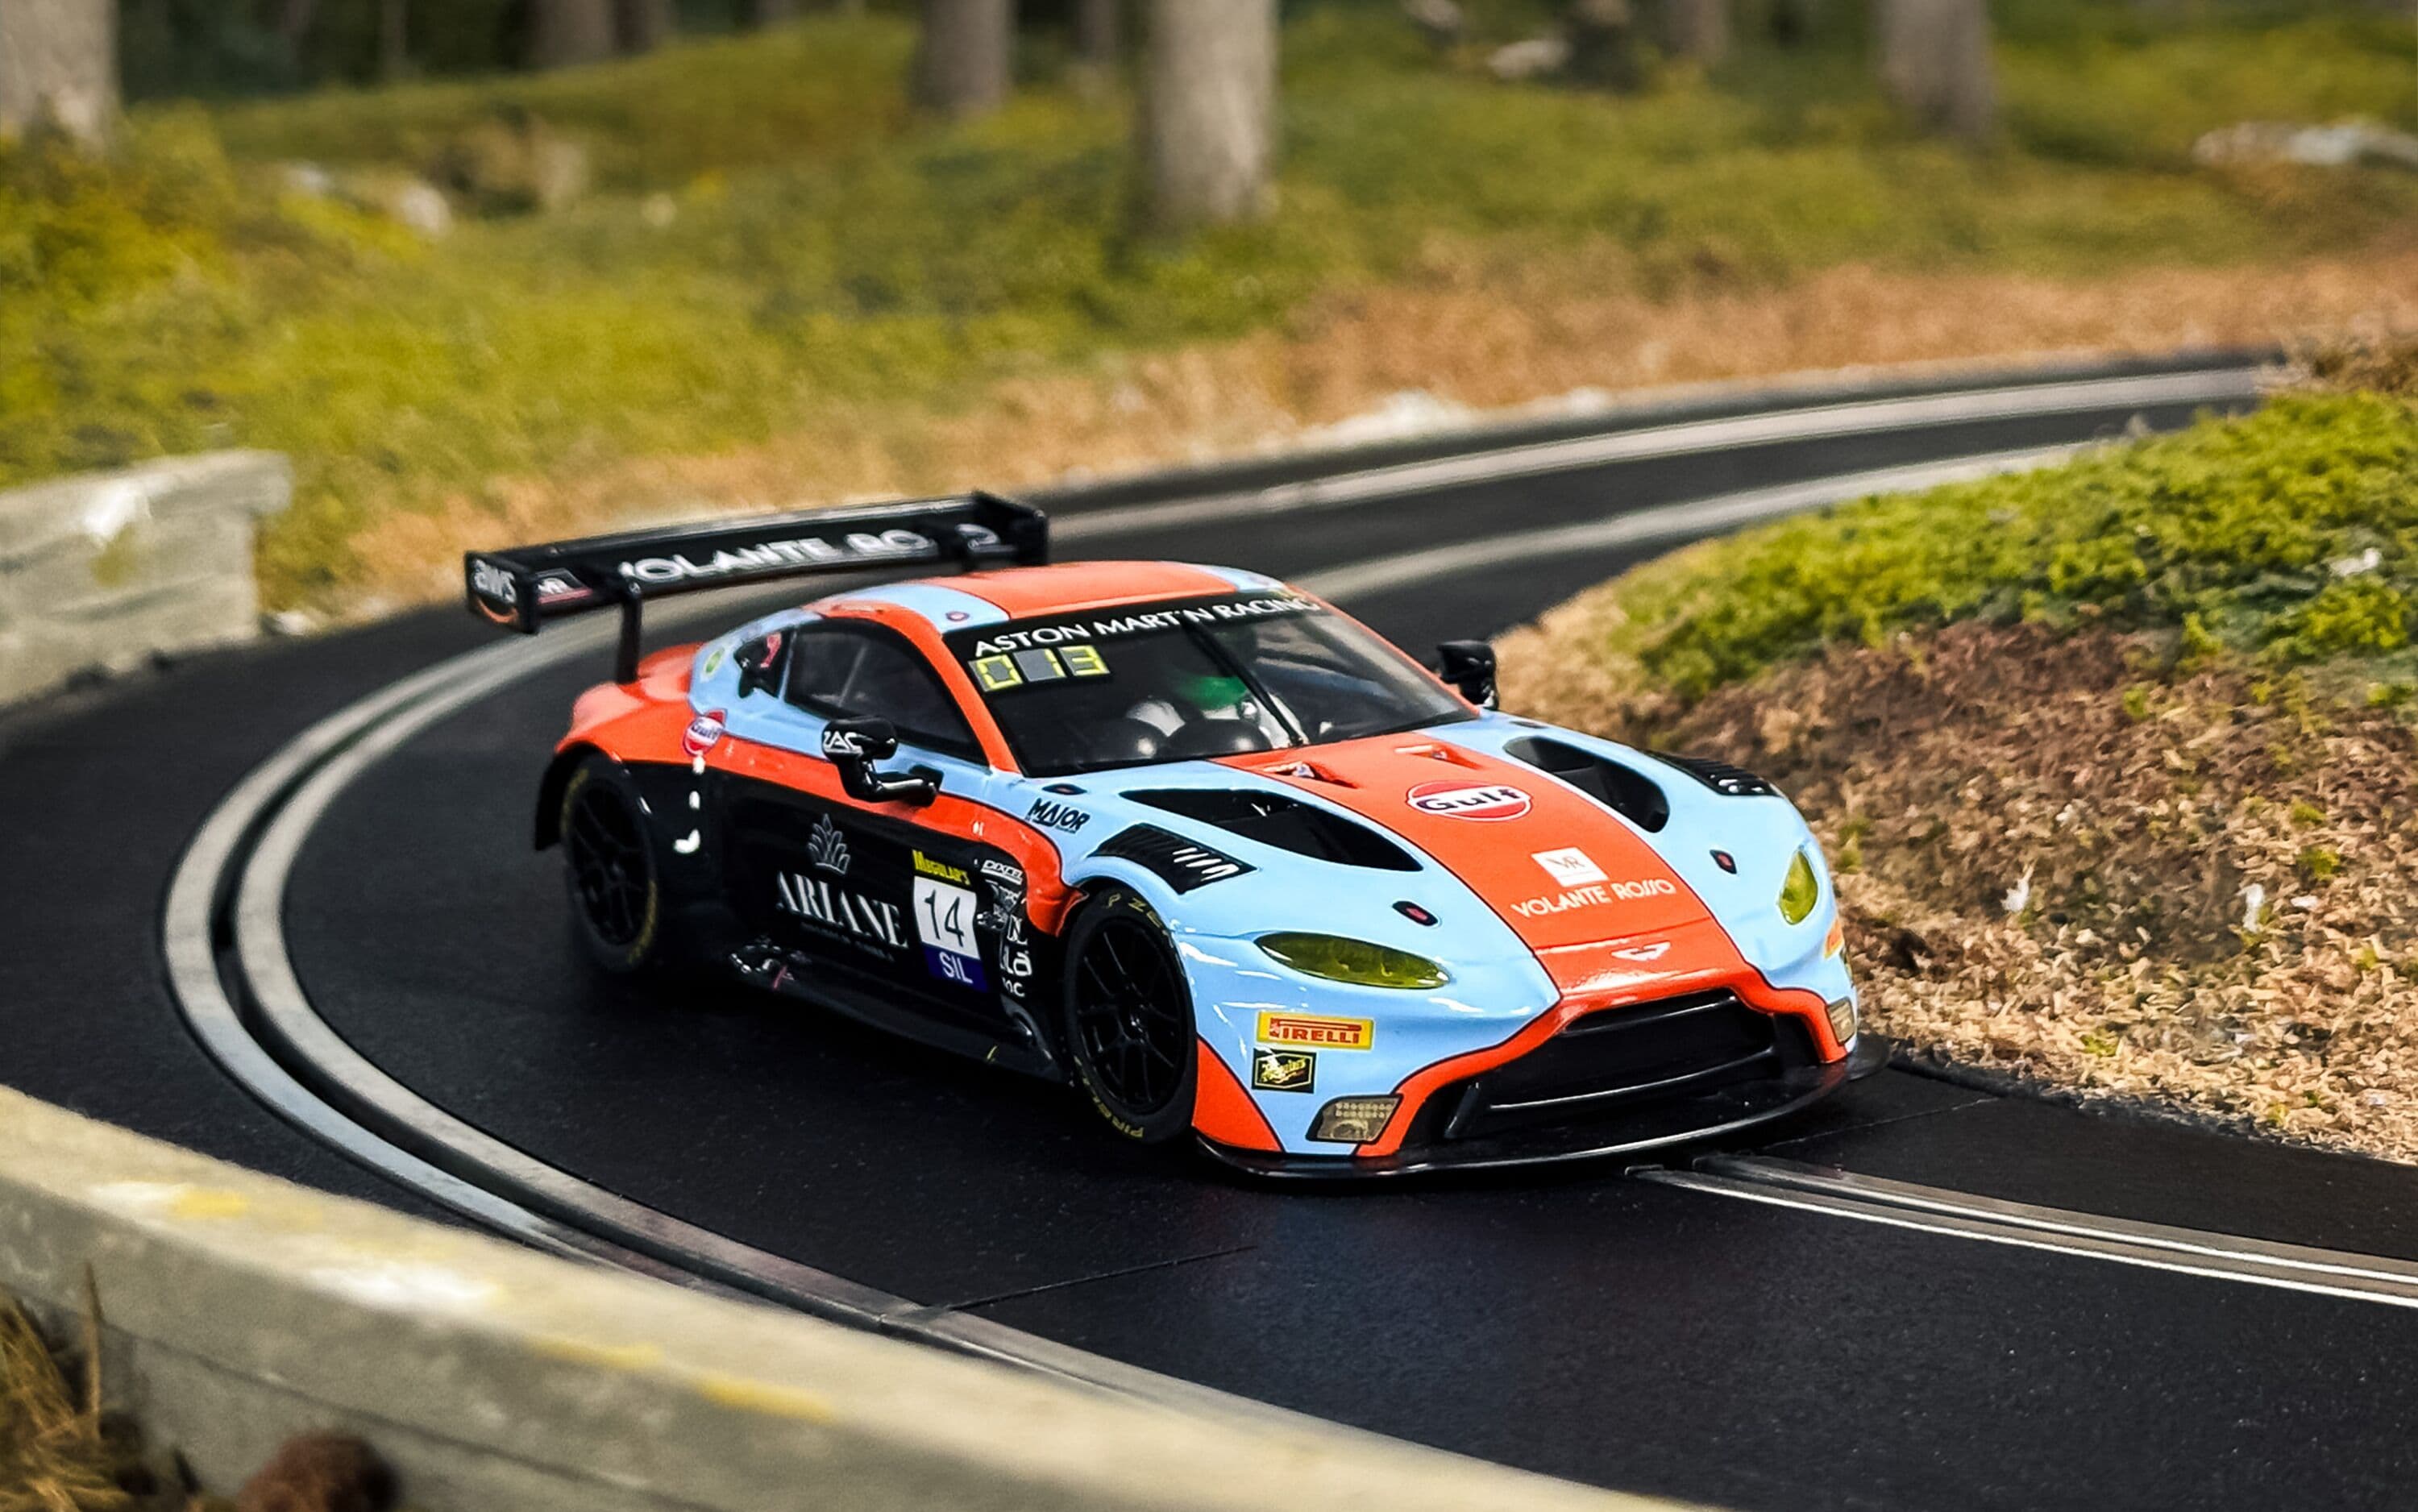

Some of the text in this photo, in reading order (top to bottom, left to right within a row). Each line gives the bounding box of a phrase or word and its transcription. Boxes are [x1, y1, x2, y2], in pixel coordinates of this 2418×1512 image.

[975, 598, 1321, 657] ASTON MARTN RACING
[976, 645, 1110, 690] 013
[1028, 797, 1091, 830] MAJOR
[1416, 789, 1521, 811] Gulf
[775, 870, 908, 949] ARIANE
[1510, 879, 1676, 918] VOLANTE ROSSO
[924, 889, 964, 948] 14
[939, 951, 973, 984] SIL
[1269, 1017, 1362, 1045] PIRELLI
